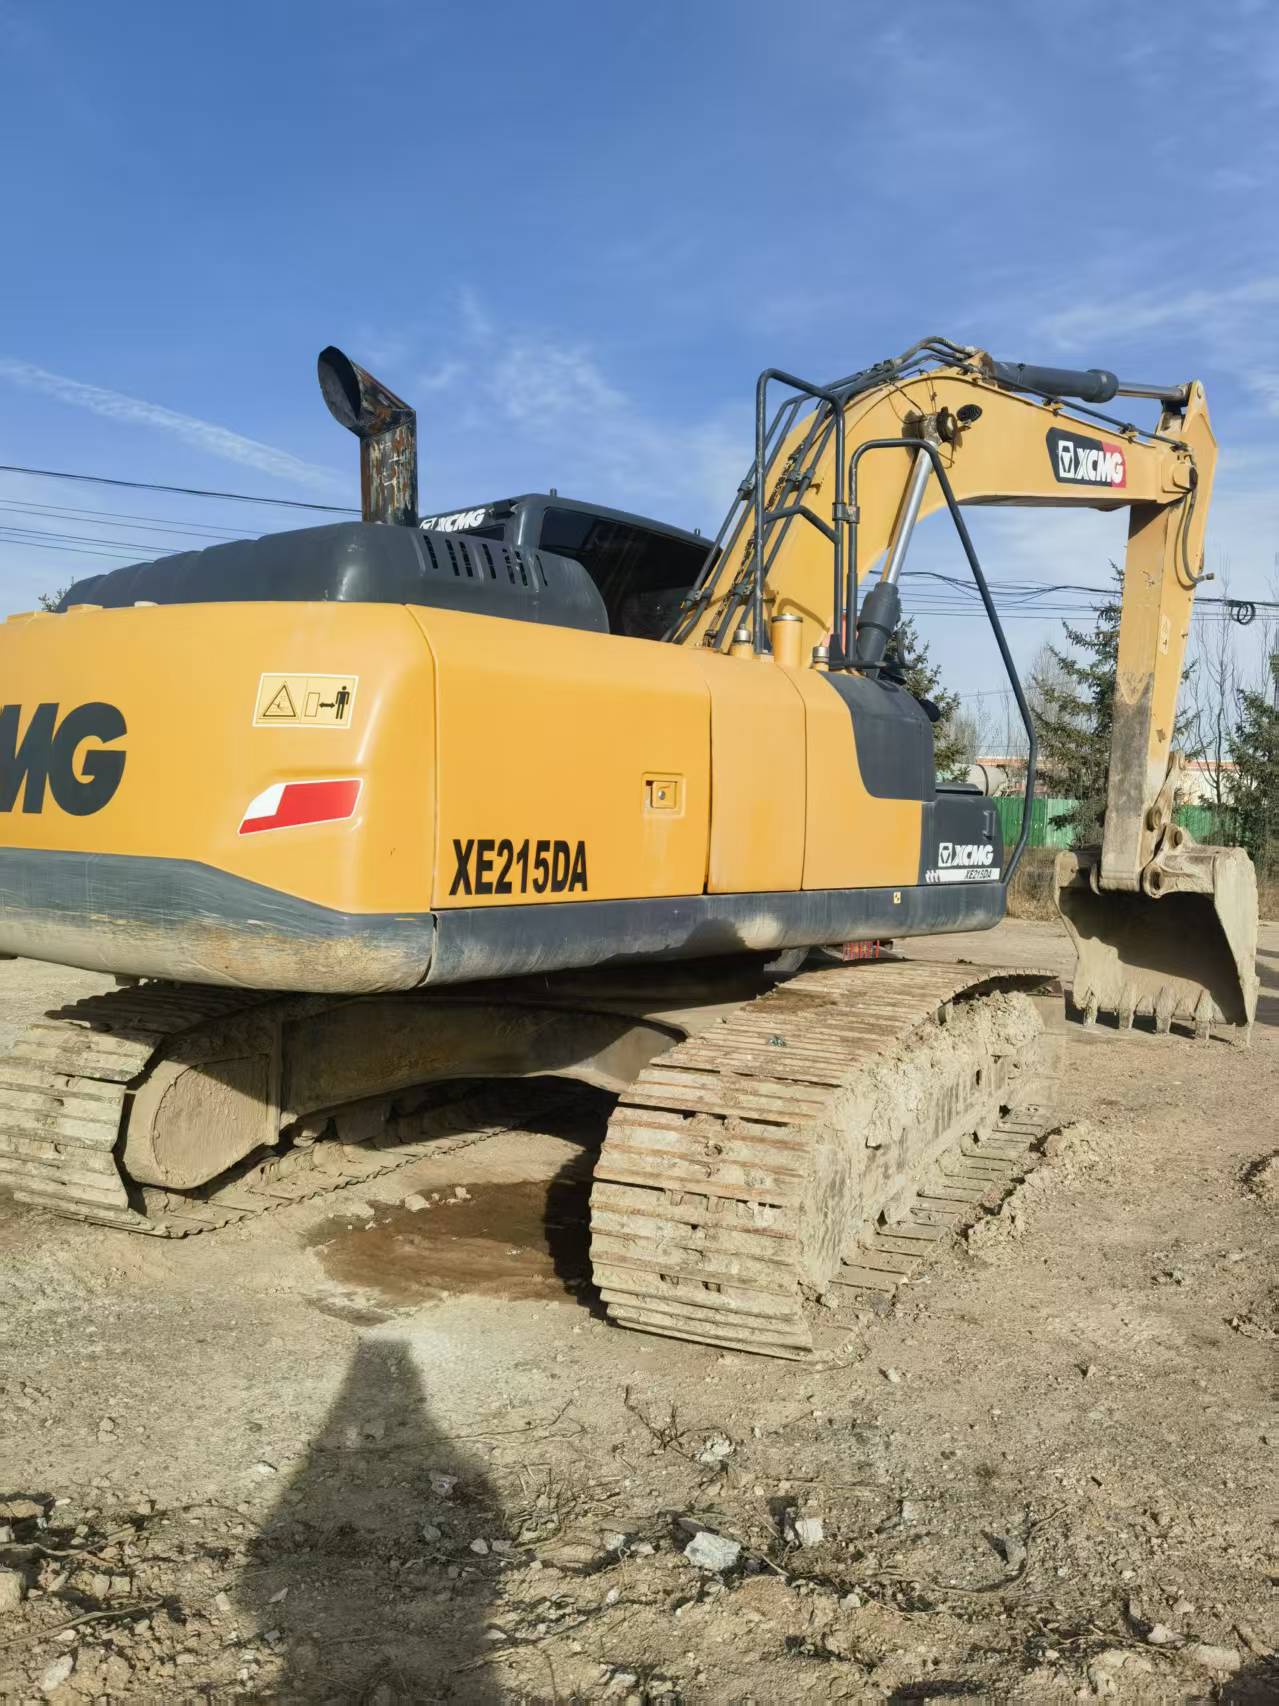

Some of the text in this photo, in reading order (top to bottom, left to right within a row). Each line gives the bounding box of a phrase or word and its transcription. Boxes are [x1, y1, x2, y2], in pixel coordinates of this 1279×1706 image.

[1075, 448, 1124, 484] XCMG
[435, 508, 486, 532] XCMG
[448, 838, 588, 896] XE215DA
[952, 844, 994, 866] XCMG
